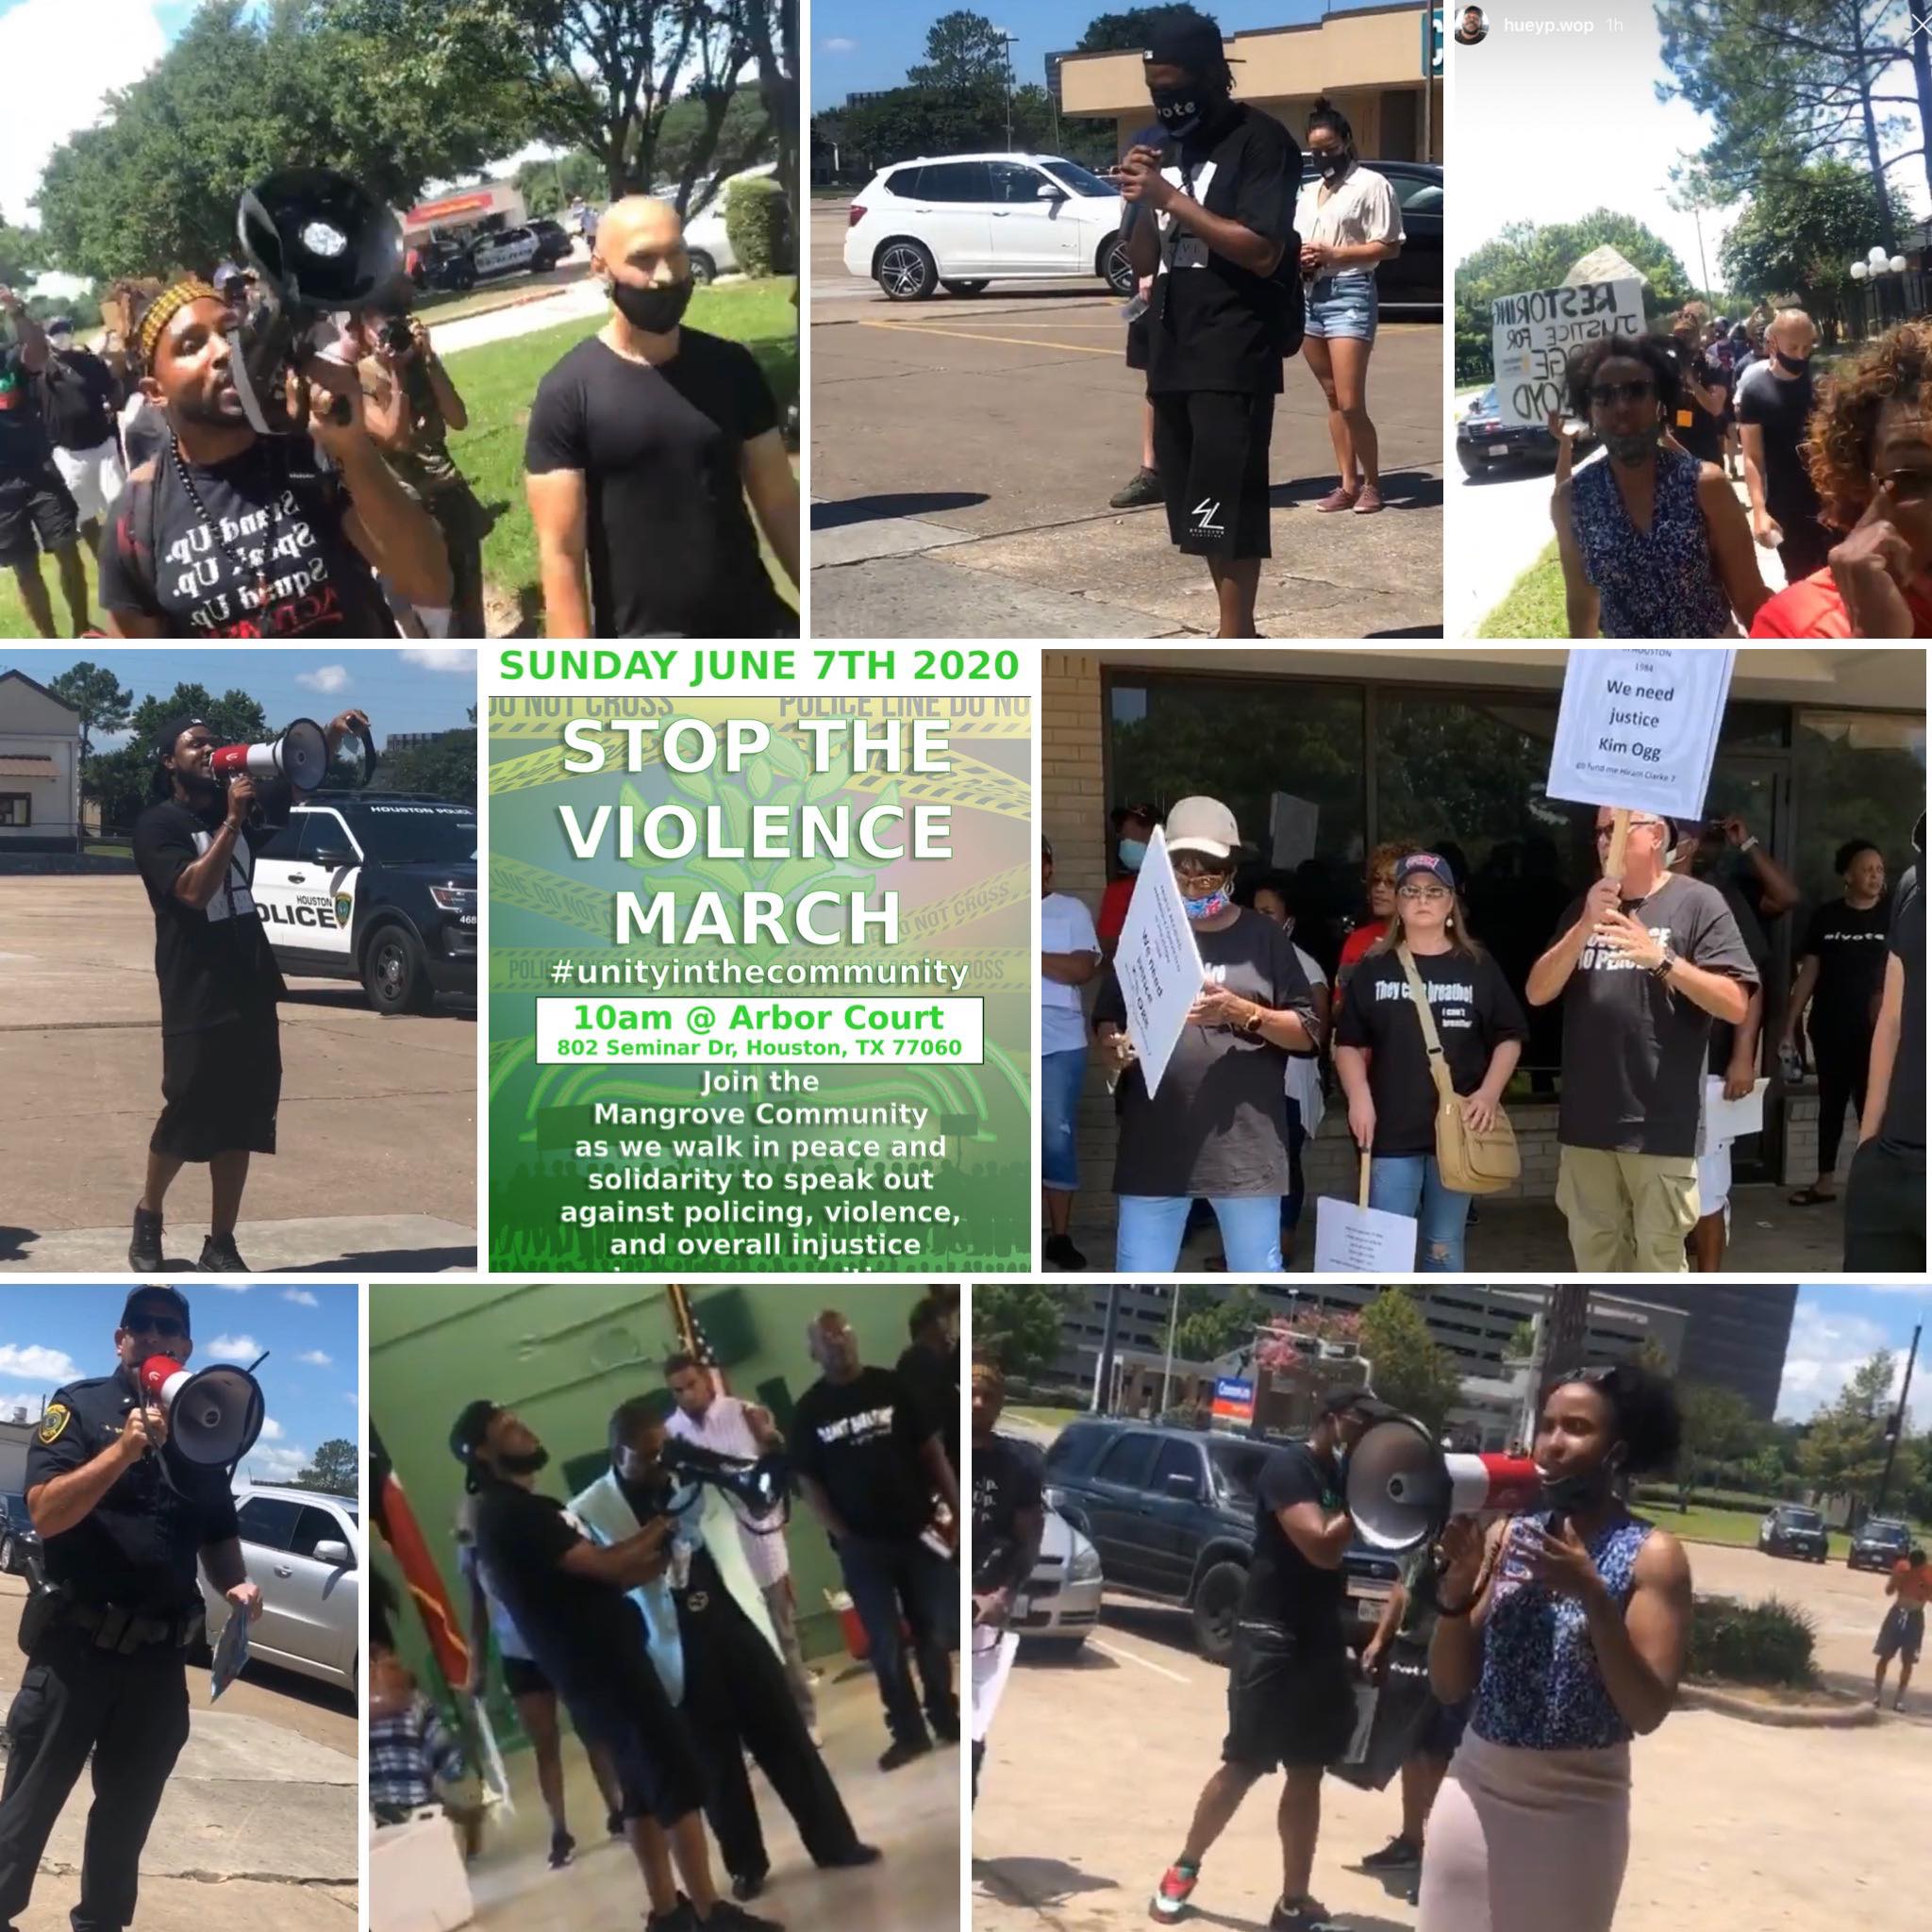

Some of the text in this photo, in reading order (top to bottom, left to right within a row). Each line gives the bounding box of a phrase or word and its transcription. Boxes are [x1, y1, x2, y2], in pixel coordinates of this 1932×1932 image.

[500, 649, 1020, 687] SUNDAY JUNE 7TH 2020
[1607, 679, 1674, 701] We need
[1608, 708, 1659, 727] justice
[563, 718, 771, 774] STOP
[798, 718, 952, 774] THE
[1598, 738, 1662, 762] Kim Ogg
[371, 806, 434, 814] HOUSTON
[558, 804, 952, 860] VIOLENCE
[296, 895, 332, 907] HOUSTON
[954, 881, 1011, 917] CROSS
[256, 903, 338, 930] OLICE
[616, 890, 899, 945] MARCH
[551, 958, 969, 991] #unityinthecommunity
[1375, 979, 1400, 1001] They
[575, 1003, 944, 1036] 10am @ Arbor Court
[558, 1039, 963, 1058] 802 Seminar Dr, Houston, TX 77060
[700, 1071, 819, 1096] Join the
[595, 1102, 928, 1129] Mangrove Community
[575, 1135, 945, 1161] as we walk in peace and
[589, 1168, 934, 1194] solidarity to speak out
[560, 1200, 959, 1227] against policing, violence,
[611, 1233, 921, 1259] and overall injustice
